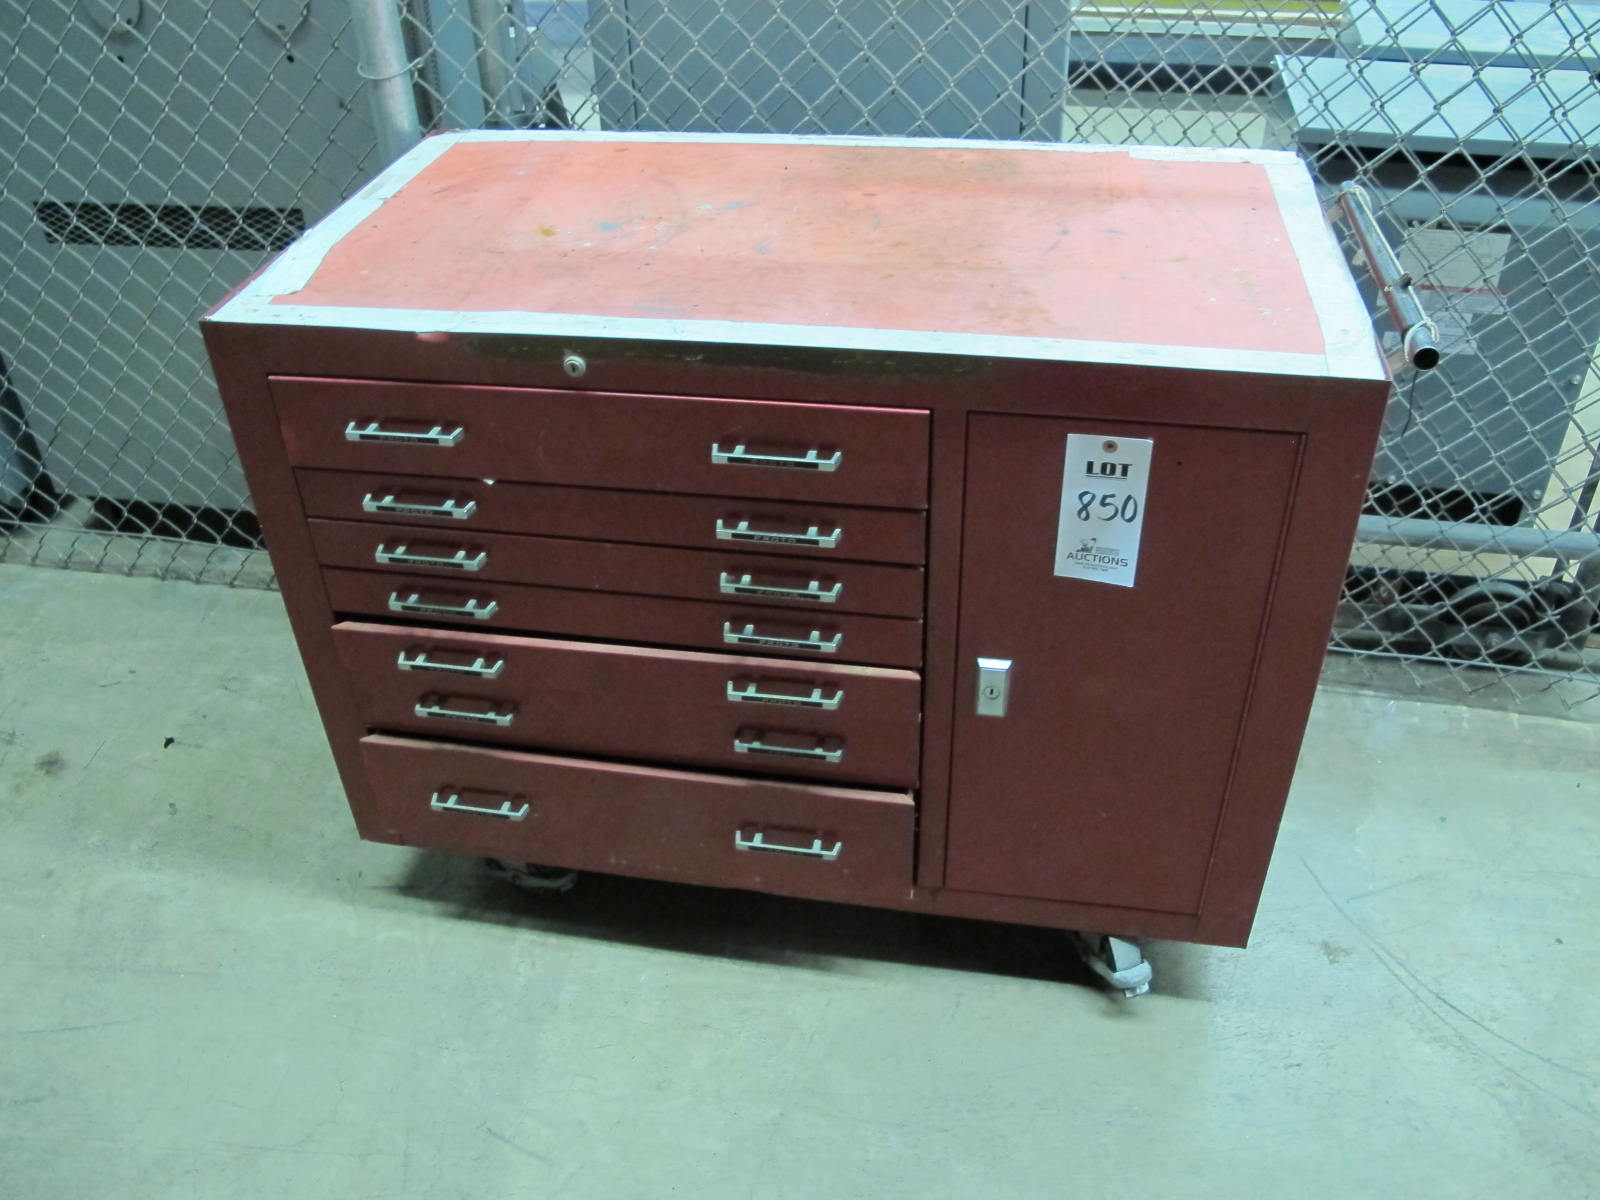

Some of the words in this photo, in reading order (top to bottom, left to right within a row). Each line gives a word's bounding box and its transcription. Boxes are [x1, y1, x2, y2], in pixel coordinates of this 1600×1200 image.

[1085, 461, 1132, 478] LOT
[1077, 491, 1138, 523] 850
[1066, 551, 1128, 567] AUCTIONS
